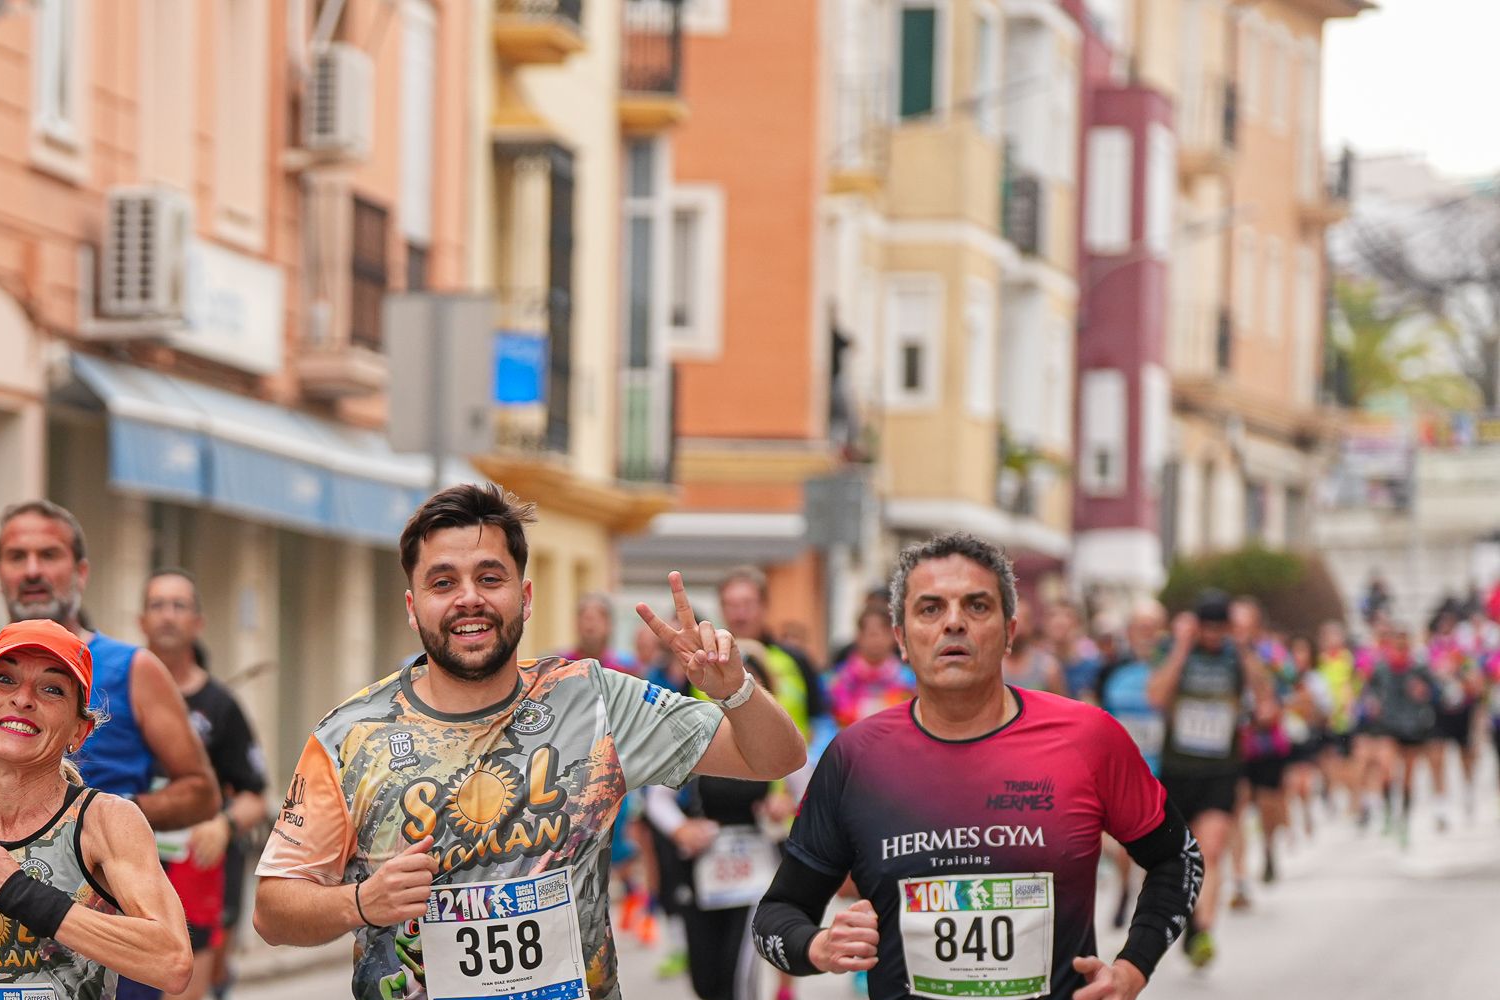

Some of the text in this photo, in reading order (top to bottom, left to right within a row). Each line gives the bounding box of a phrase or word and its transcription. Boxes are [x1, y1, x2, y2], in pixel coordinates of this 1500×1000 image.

[987, 794, 1055, 812] HERMES
[881, 825, 1047, 861] HERMES GYM
[930, 854, 991, 868] Training
[438, 887, 490, 921] 21K
[518, 901, 536, 913] 2026
[915, 880, 960, 912] 10K
[456, 919, 544, 978] 358
[934, 915, 1014, 963] 840
